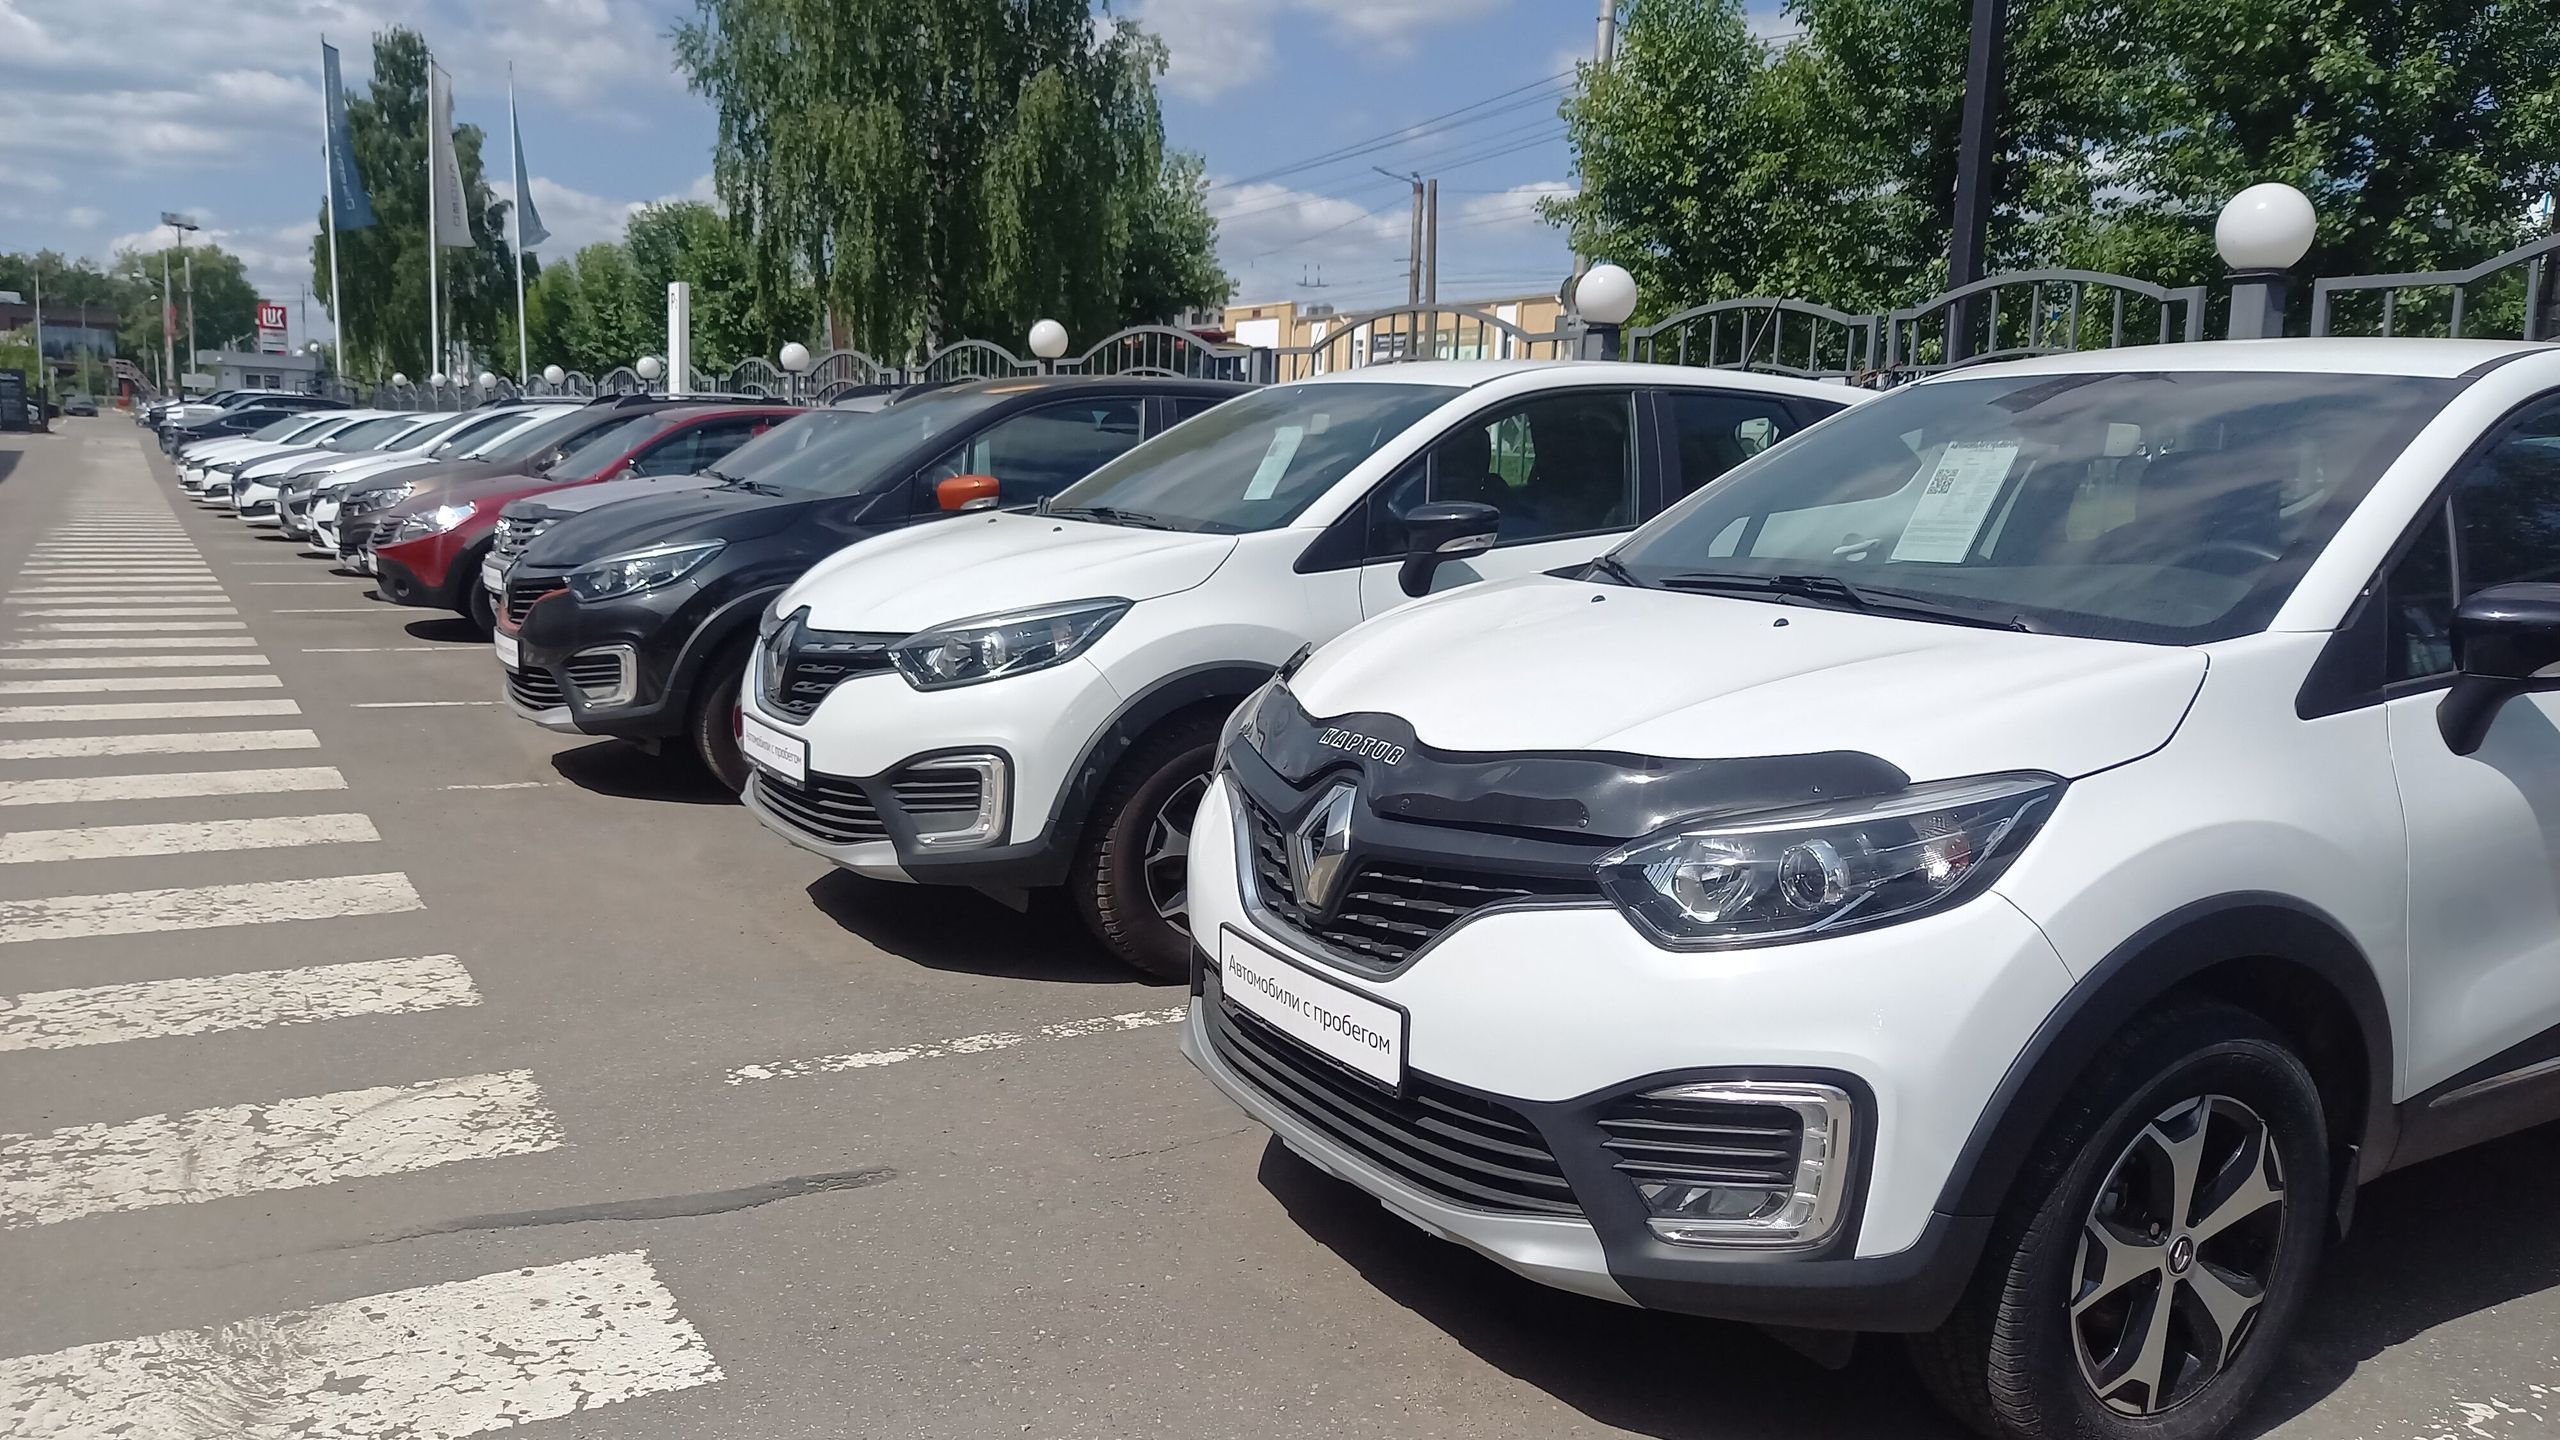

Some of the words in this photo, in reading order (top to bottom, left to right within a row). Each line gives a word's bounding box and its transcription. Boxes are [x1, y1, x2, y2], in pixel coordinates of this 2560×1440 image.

[1318, 727, 1406, 766] KAPTUR
[1228, 954, 1300, 1012] Автомобили
[1303, 1000, 1310, 1018] с
[1313, 1005, 1390, 1055] пробегом
